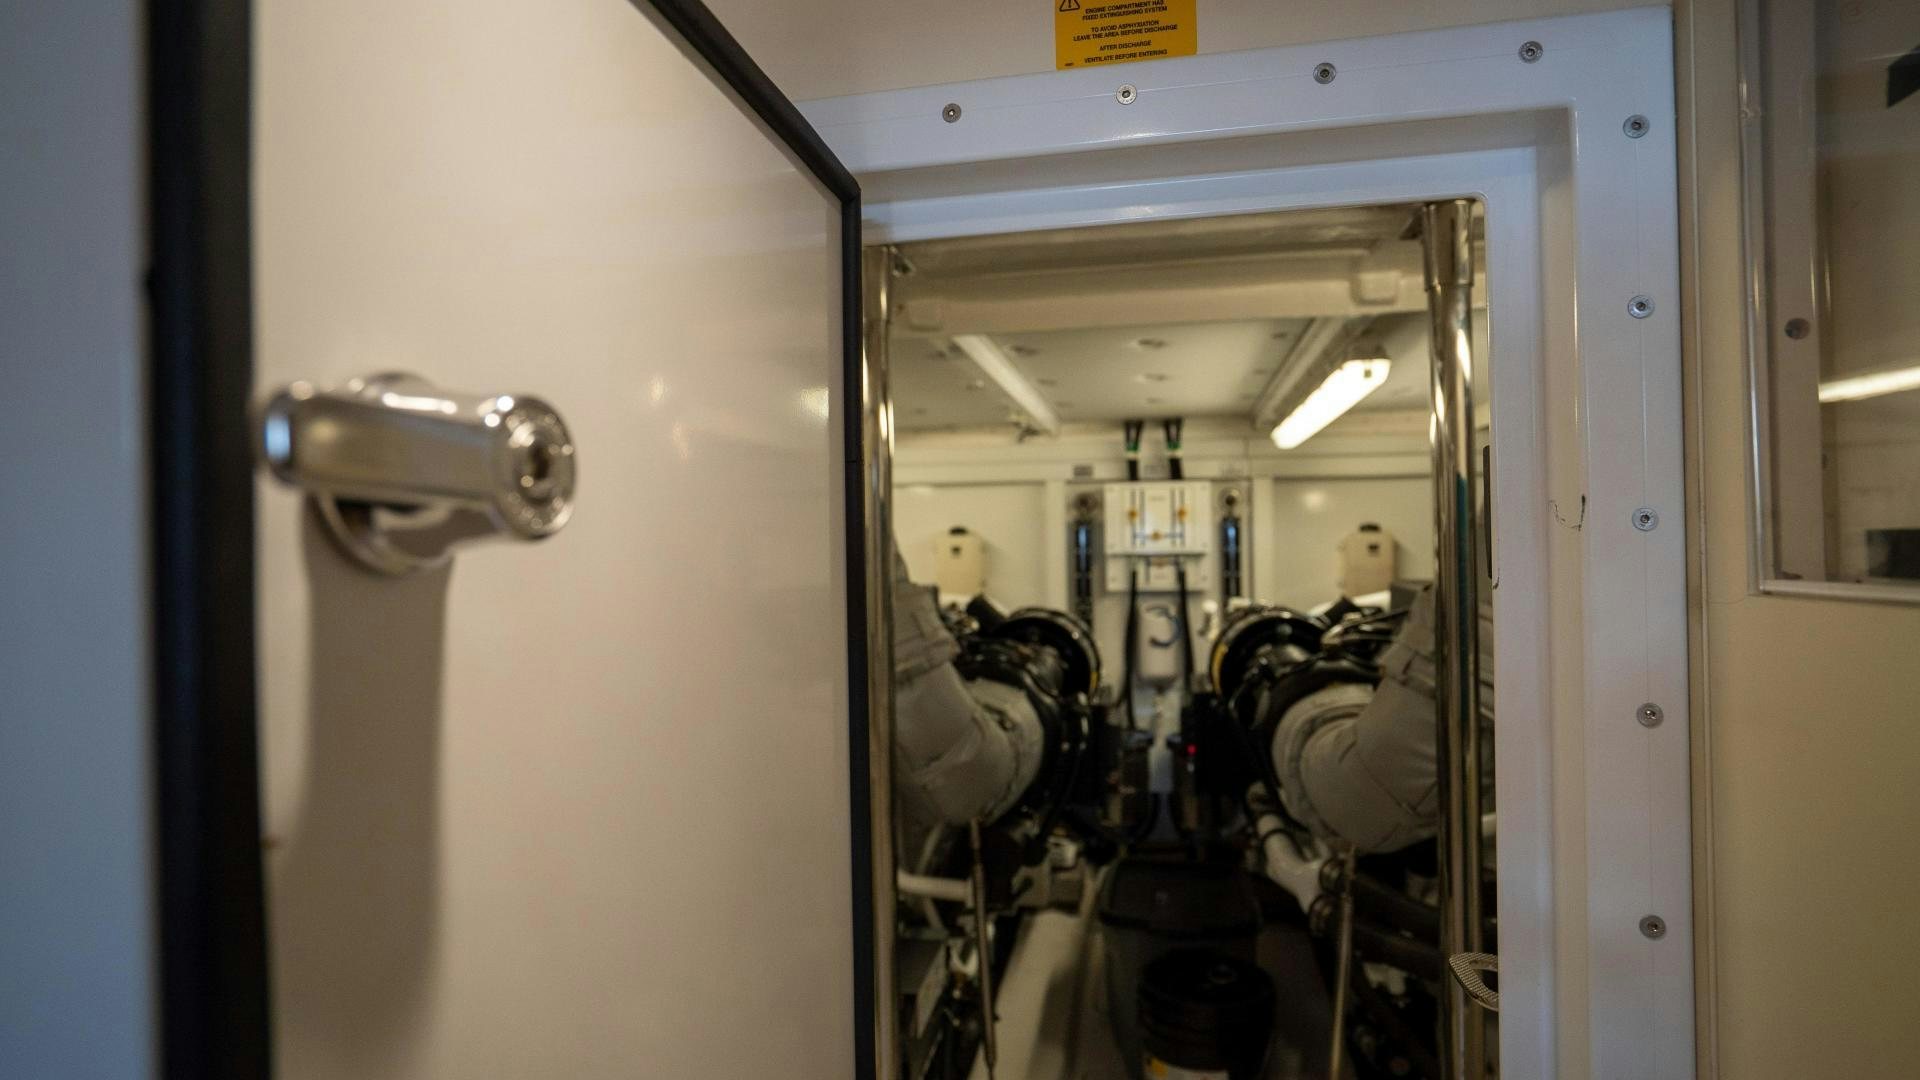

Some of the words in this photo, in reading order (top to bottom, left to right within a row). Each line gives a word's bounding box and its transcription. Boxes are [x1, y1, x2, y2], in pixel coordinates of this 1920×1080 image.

[1108, 2, 1151, 11] COMPARTMENT
[1100, 9, 1143, 19] EXTINGUISHING
[1118, 20, 1159, 30] ASPHYXIATION
[1073, 34, 1091, 42] LEAVE
[1120, 28, 1143, 36] BEFORE
[1144, 24, 1178, 33] DISCHARGE
[1118, 40, 1152, 49] DISCHARGE
[1084, 55, 1114, 64] VENTILATE
[1115, 52, 1138, 60] BEFORE
[1138, 49, 1168, 58] ENTERING
